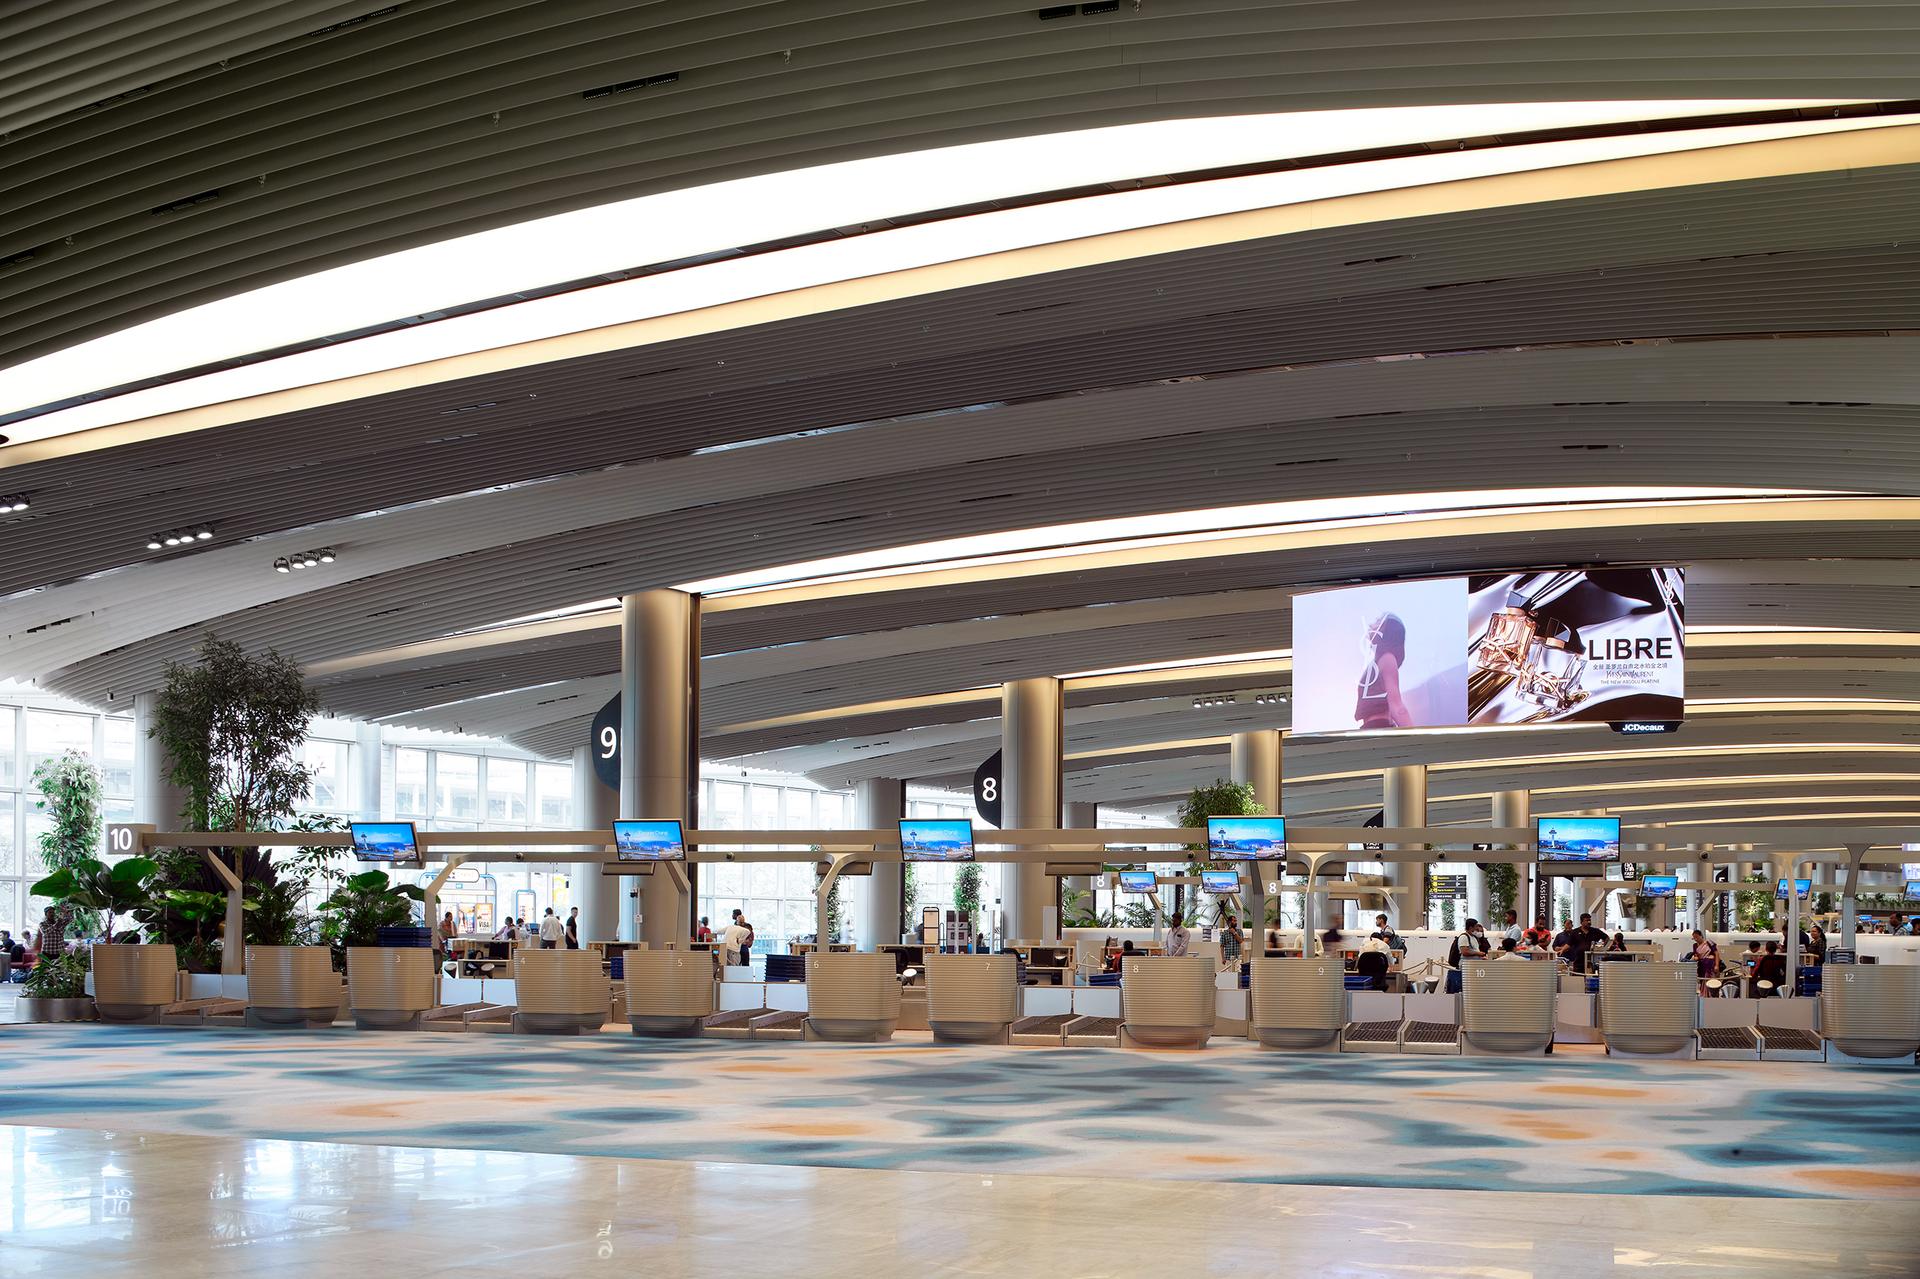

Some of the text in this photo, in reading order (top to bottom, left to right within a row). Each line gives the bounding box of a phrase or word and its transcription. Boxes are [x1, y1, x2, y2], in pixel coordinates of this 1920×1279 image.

[1588, 637, 1673, 661] LIBRE
[601, 726, 617, 759] 9
[982, 777, 997, 802] 8
[110, 828, 132, 851] 10
[1097, 875, 1104, 887] 8
[1269, 882, 1277, 894] 8
[395, 954, 401, 962] 3
[677, 958, 683, 967] 5
[813, 960, 819, 968] 6
[985, 962, 991, 970] 7
[1133, 965, 1139, 973] 8
[1318, 966, 1324, 975] 9
[1476, 969, 1486, 978] 10
[1674, 971, 1683, 980] 11
[1845, 973, 1854, 982] 12
